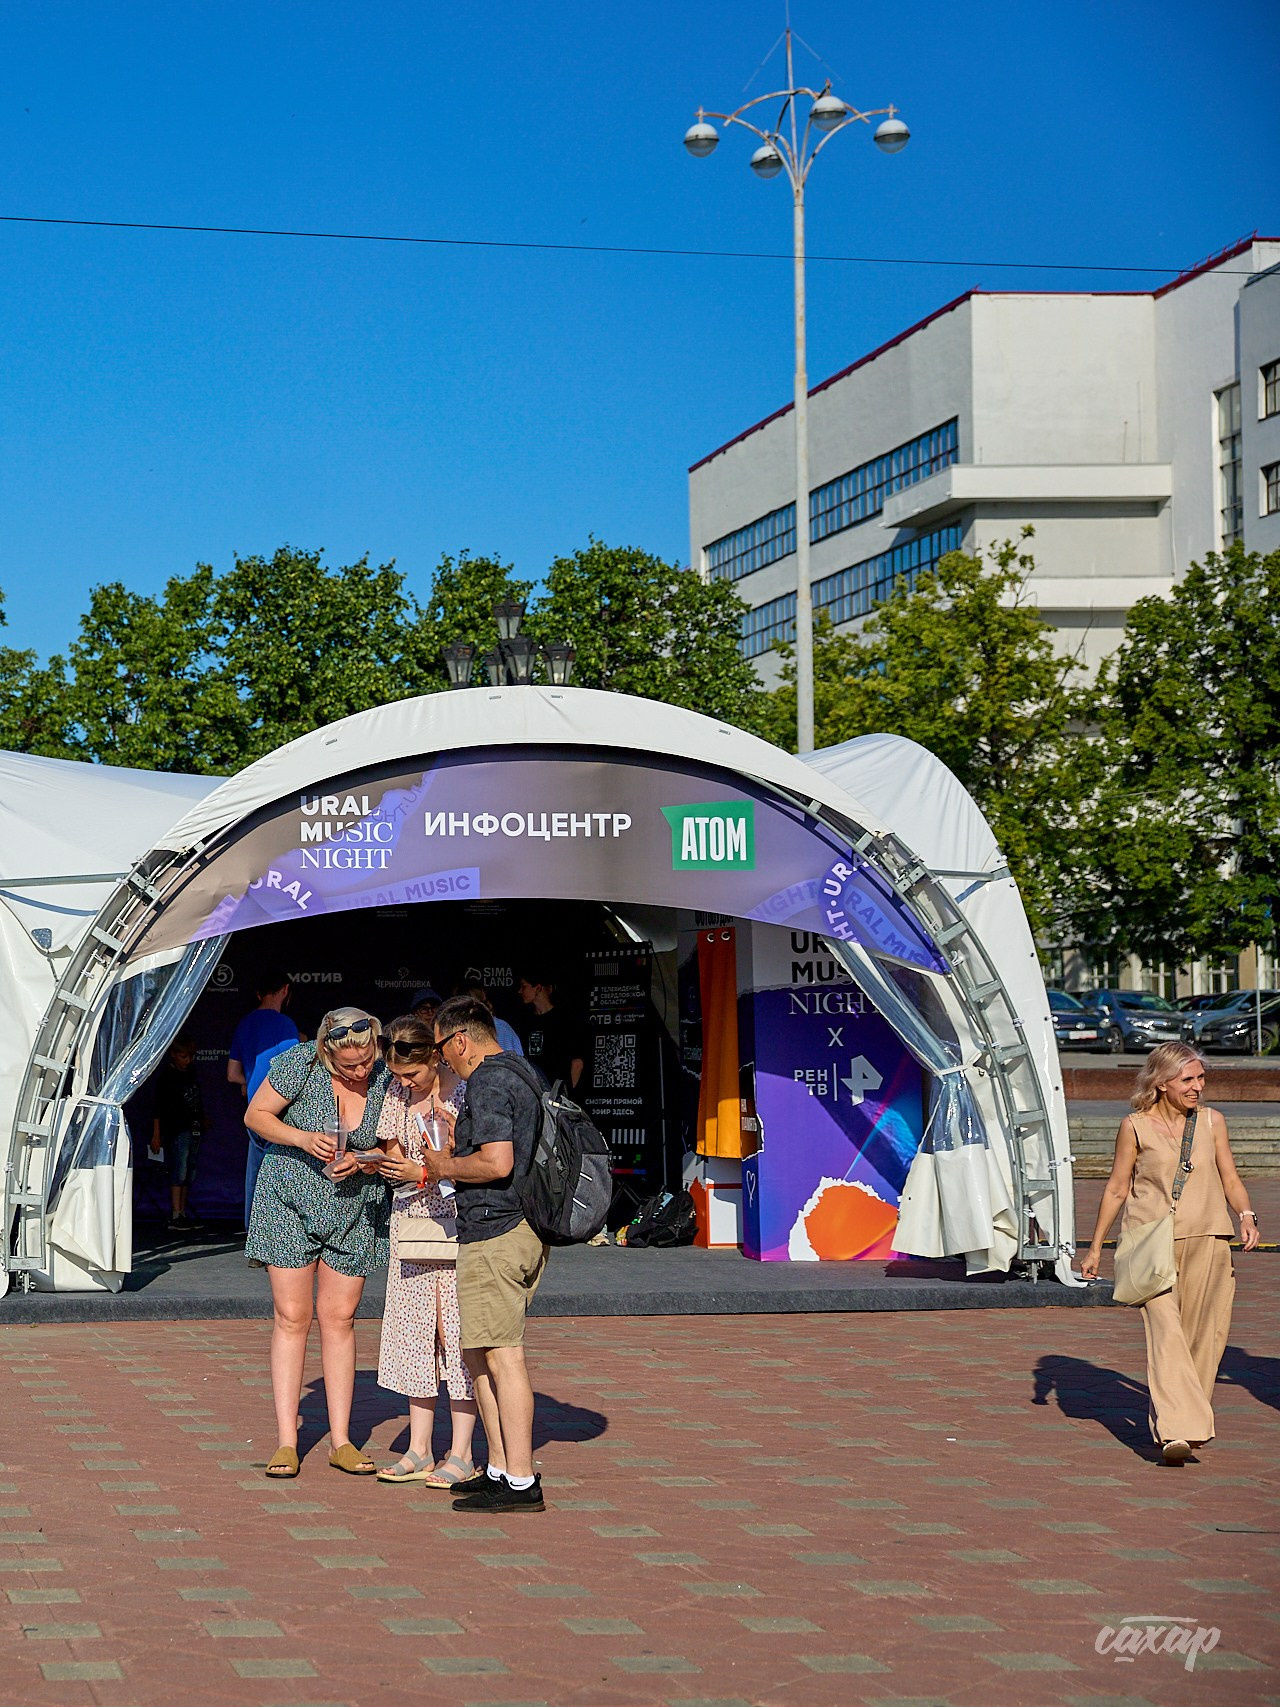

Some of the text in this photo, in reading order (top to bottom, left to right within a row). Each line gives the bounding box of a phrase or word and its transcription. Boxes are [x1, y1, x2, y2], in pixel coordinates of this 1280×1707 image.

[300, 795, 380, 816] URAL
[300, 821, 394, 843] MUSIC
[424, 811, 633, 842] ИНФОЦЕНТР
[681, 816, 747, 862] АТОМ
[300, 847, 393, 870] NIGHT
[404, 875, 471, 901] MUSIC
[845, 890, 881, 936] RAL
[791, 932, 831, 953] UR
[483, 967, 513, 977] SIMA
[483, 977, 514, 987] LAND
[792, 961, 853, 985] MUS
[196, 1048, 231, 1056] ЧЕТВЁРТЫ
[794, 1069, 828, 1082] РЕН
[806, 1083, 828, 1096] ТВ
[613, 1096, 643, 1105] ПРЯМОЙ
